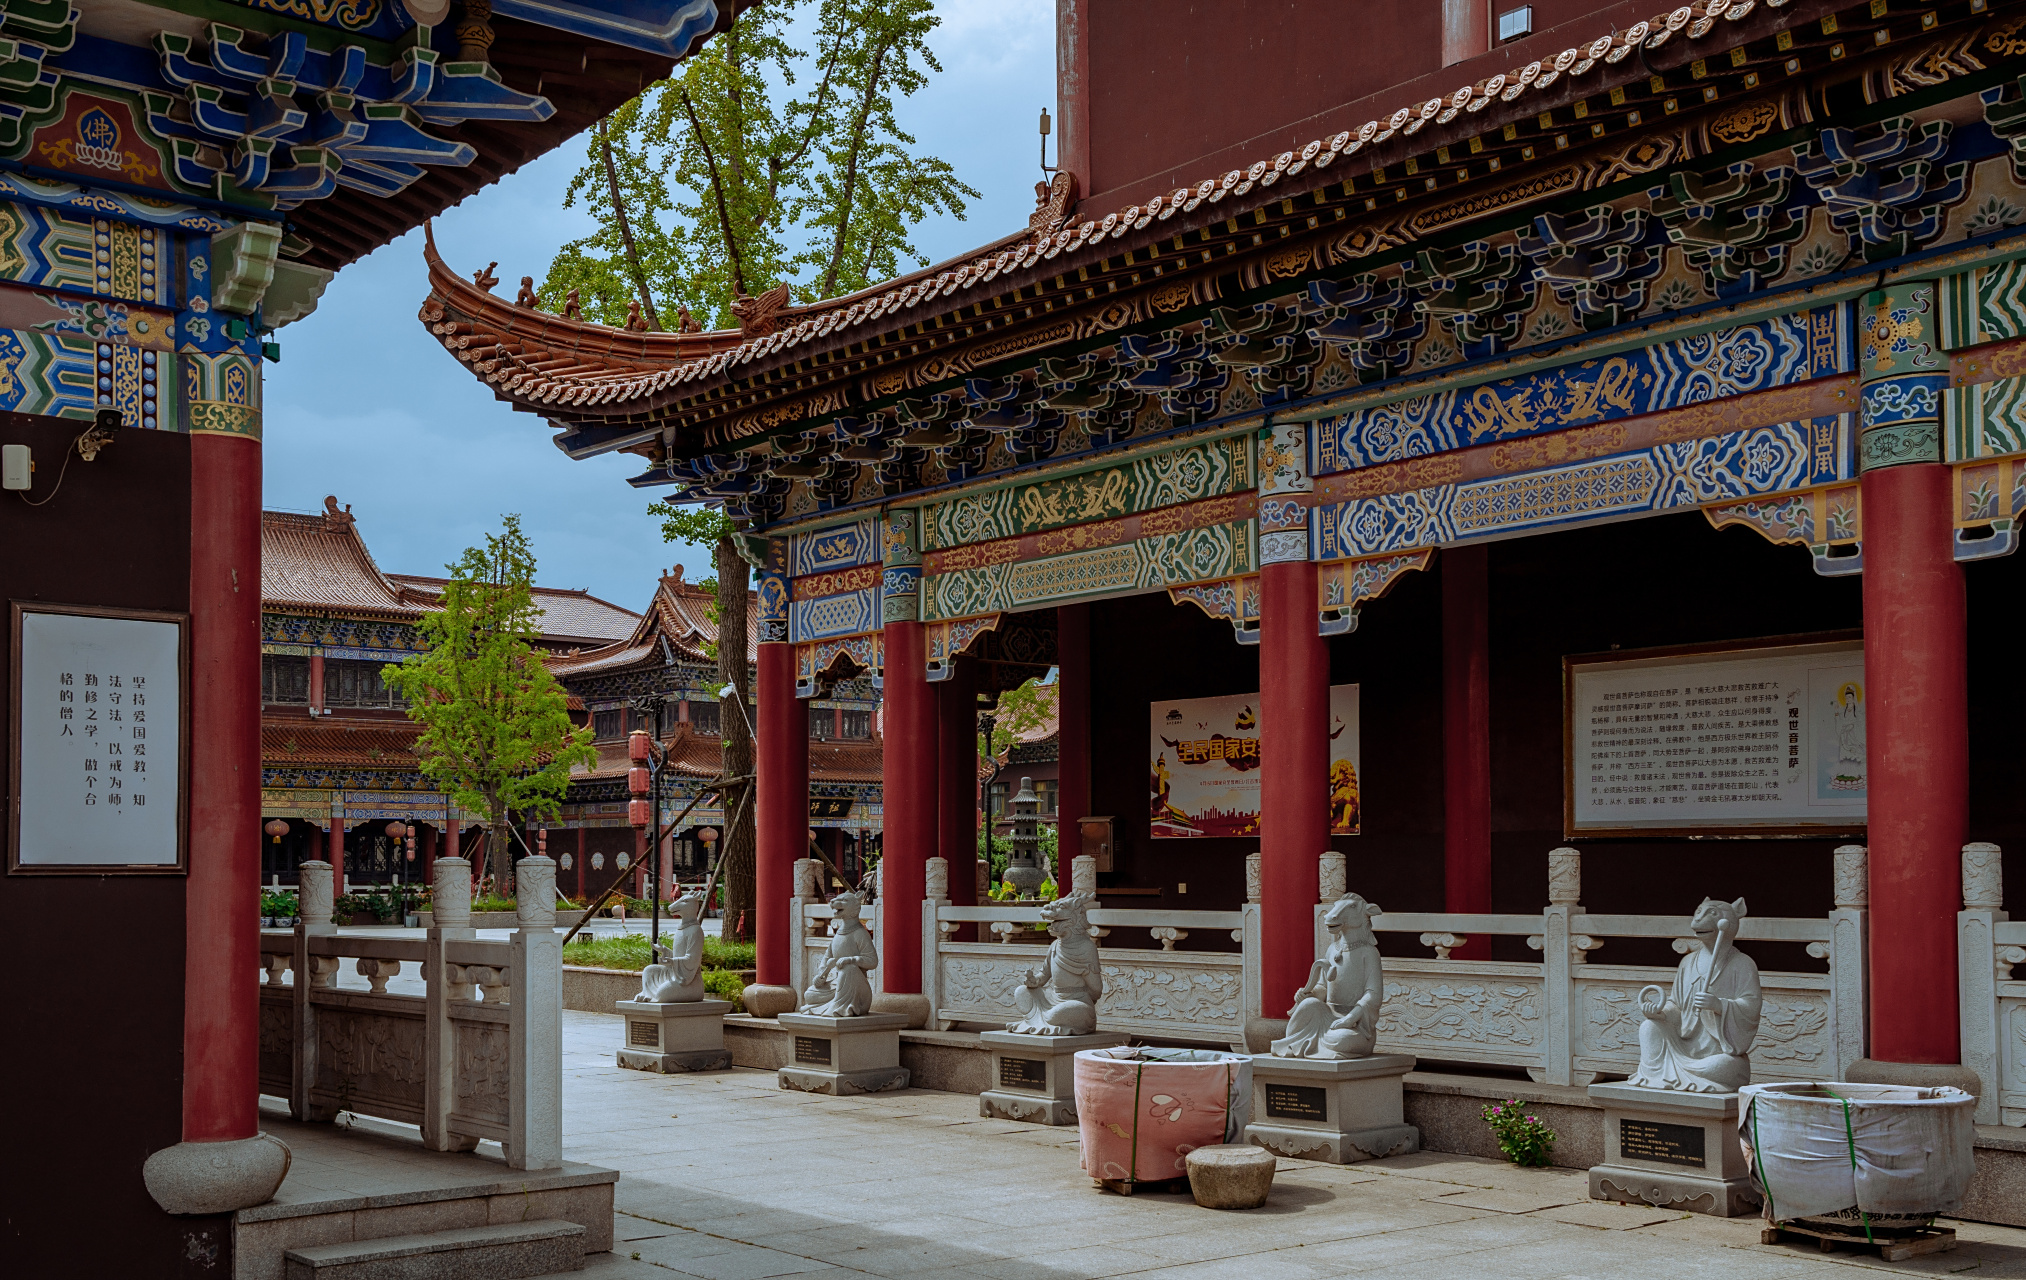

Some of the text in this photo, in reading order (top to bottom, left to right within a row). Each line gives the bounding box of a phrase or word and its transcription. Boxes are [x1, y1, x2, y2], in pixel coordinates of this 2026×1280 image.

[83, 116, 115, 148] 佛
[59, 672, 74, 746] 格的僧人。
[84, 673, 98, 806] 勤修之学，做个合
[108, 674, 123, 816] 法守法，以戒为师，
[132, 676, 146, 807] 坚持爱国爱教，知
[1788, 707, 1799, 769] 观世音菩萨
